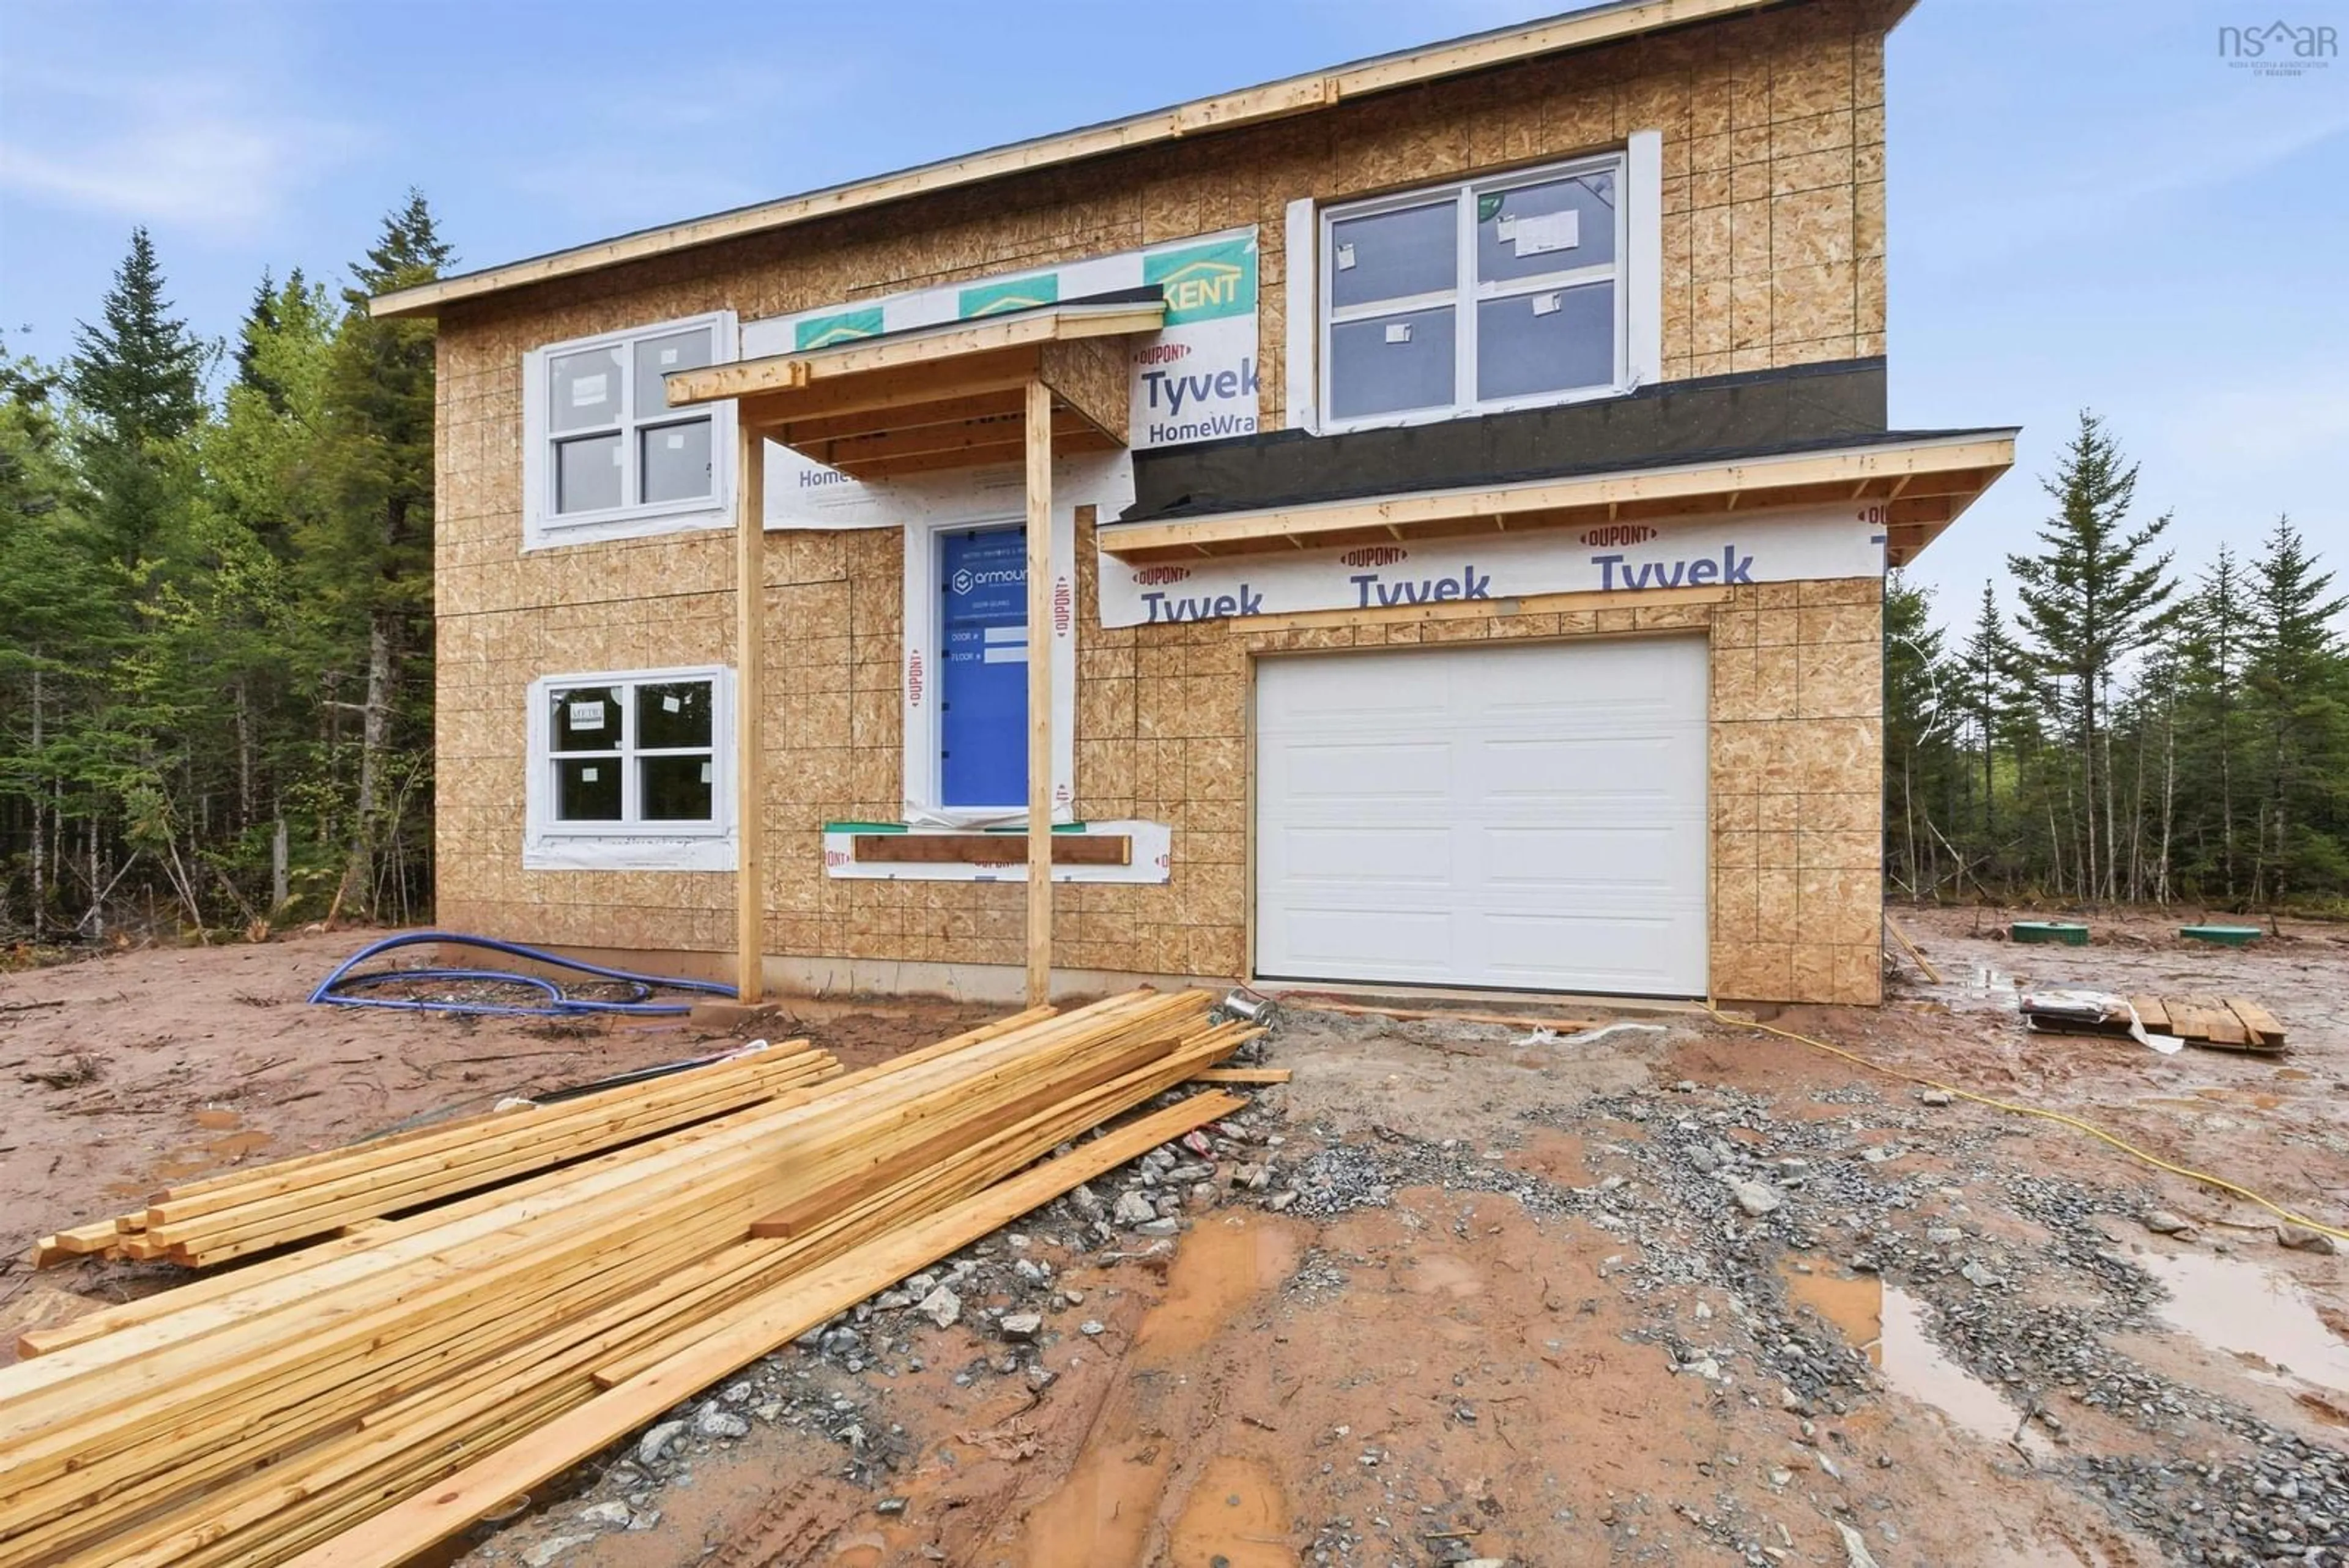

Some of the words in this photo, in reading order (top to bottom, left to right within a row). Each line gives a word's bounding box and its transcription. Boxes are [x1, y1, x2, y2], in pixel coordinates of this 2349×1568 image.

[1140, 344, 1186, 365] DUPONT
[1141, 358, 1260, 417] Tyvek
[1150, 415, 1258, 443] HomeWra
[1589, 525, 1649, 547] DUPONT
[1348, 547, 1400, 568] DUPONT
[1139, 567, 1184, 585] DUPONT
[1054, 583, 1071, 630] DUPONT
[908, 656, 923, 700] DUPONT
[826, 850, 845, 866] ONT
